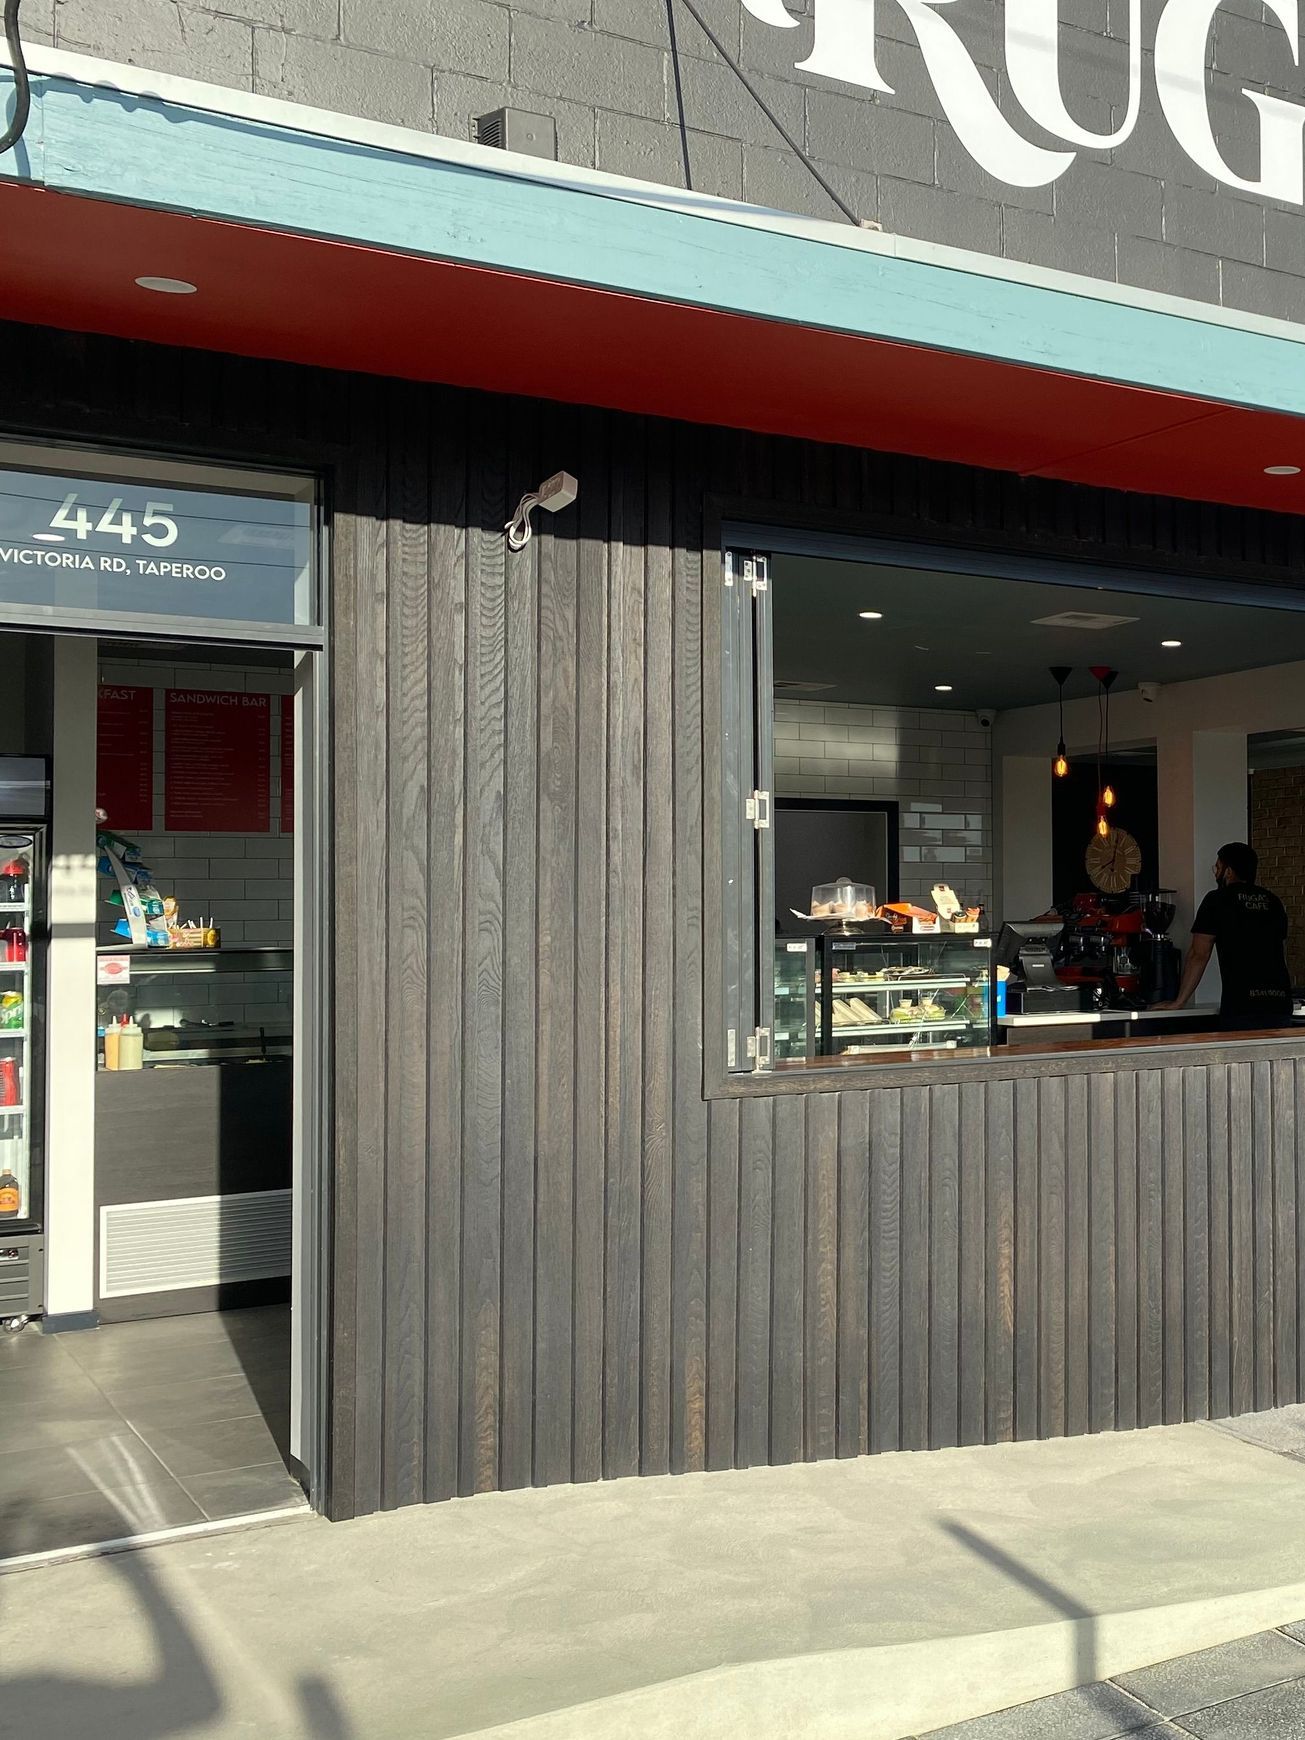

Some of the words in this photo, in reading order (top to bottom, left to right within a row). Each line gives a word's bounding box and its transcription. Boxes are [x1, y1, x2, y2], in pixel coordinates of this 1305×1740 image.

[49, 493, 179, 548] 445
[0, 547, 95, 570] VICTORIA
[99, 556, 132, 576] RD,
[136, 559, 226, 581] TAPEROO
[170, 692, 239, 706] SANDWICH
[242, 697, 267, 708] BAR
